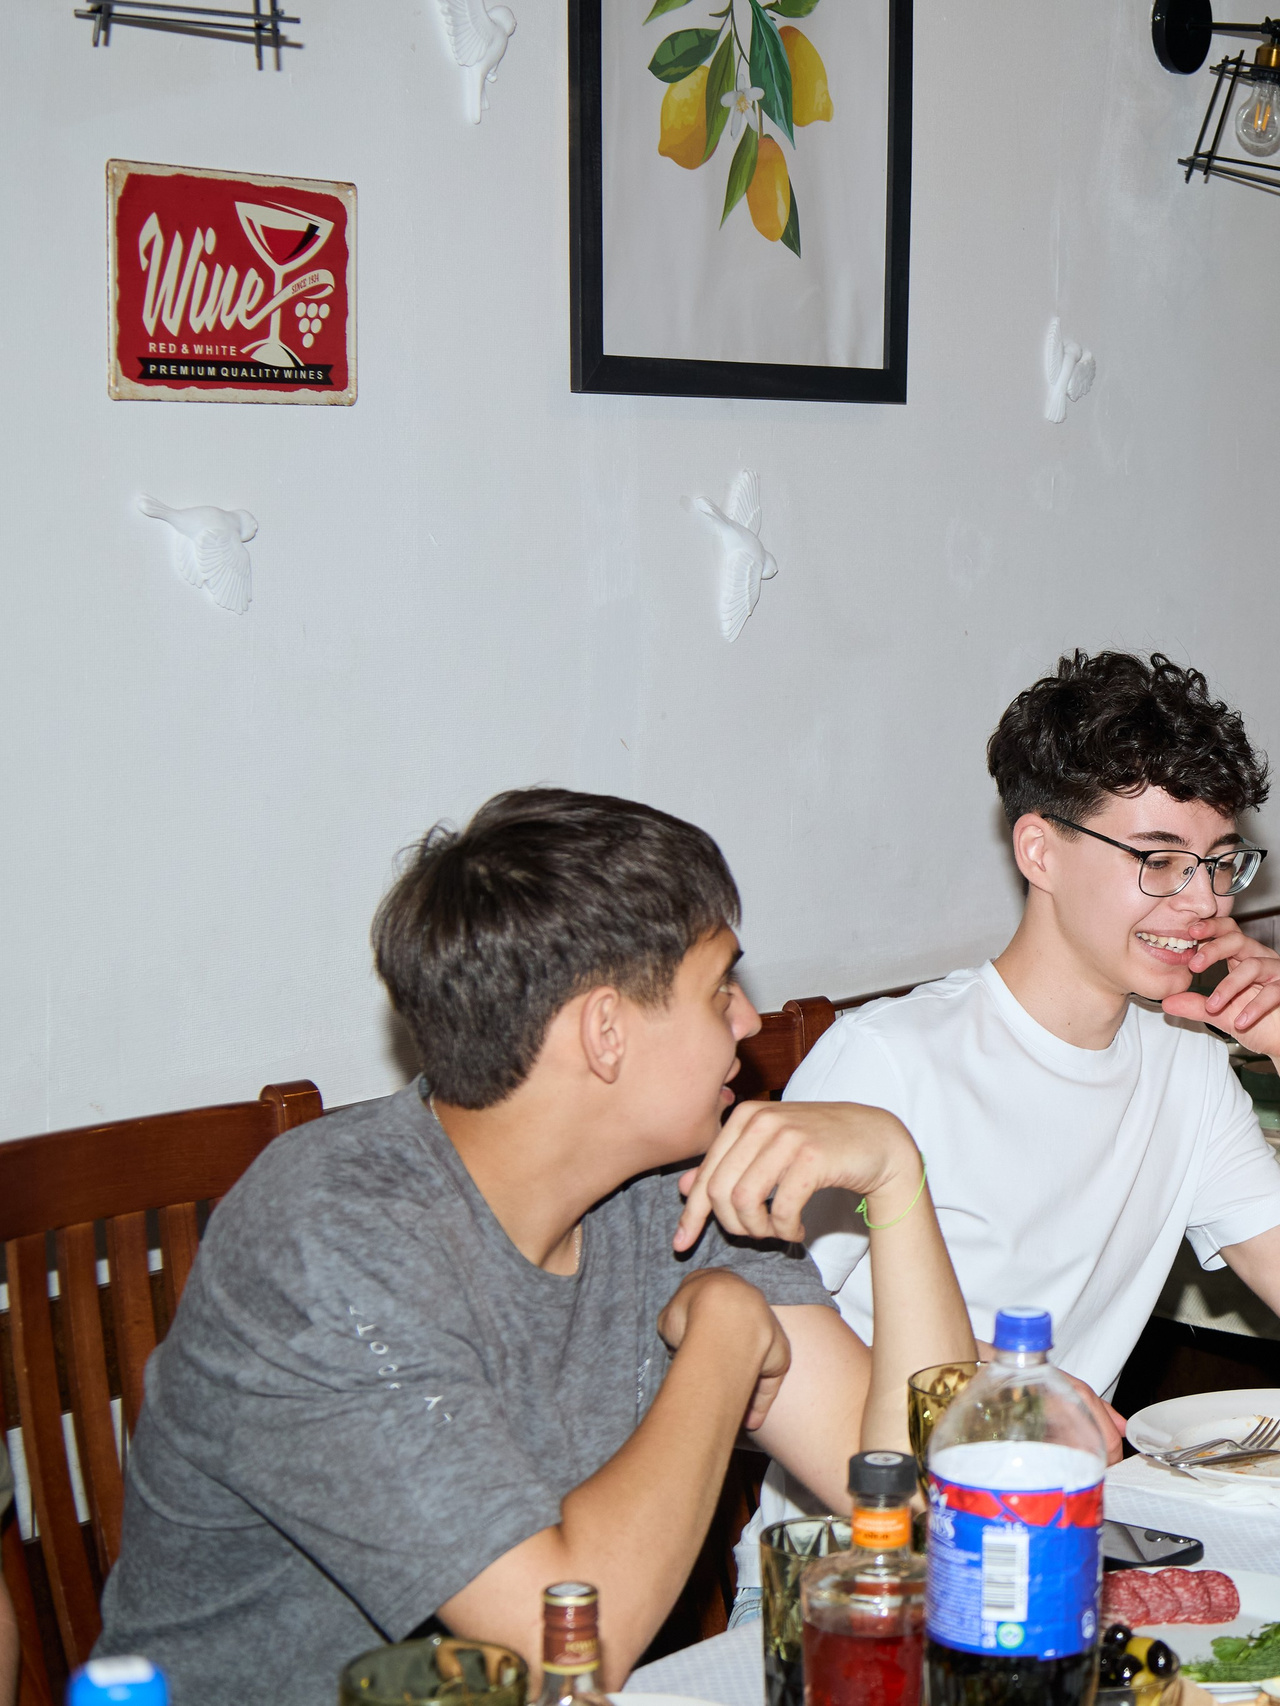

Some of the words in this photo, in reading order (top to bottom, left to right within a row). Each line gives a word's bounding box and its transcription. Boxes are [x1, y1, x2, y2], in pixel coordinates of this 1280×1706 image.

[139, 211, 265, 337] Wine
[148, 342, 177, 354] RED
[181, 343, 190, 355] &
[193, 344, 237, 356] WHITE
[149, 364, 216, 376] PREMIUM
[220, 367, 280, 378] QUALITY
[283, 369, 324, 380] WINES
